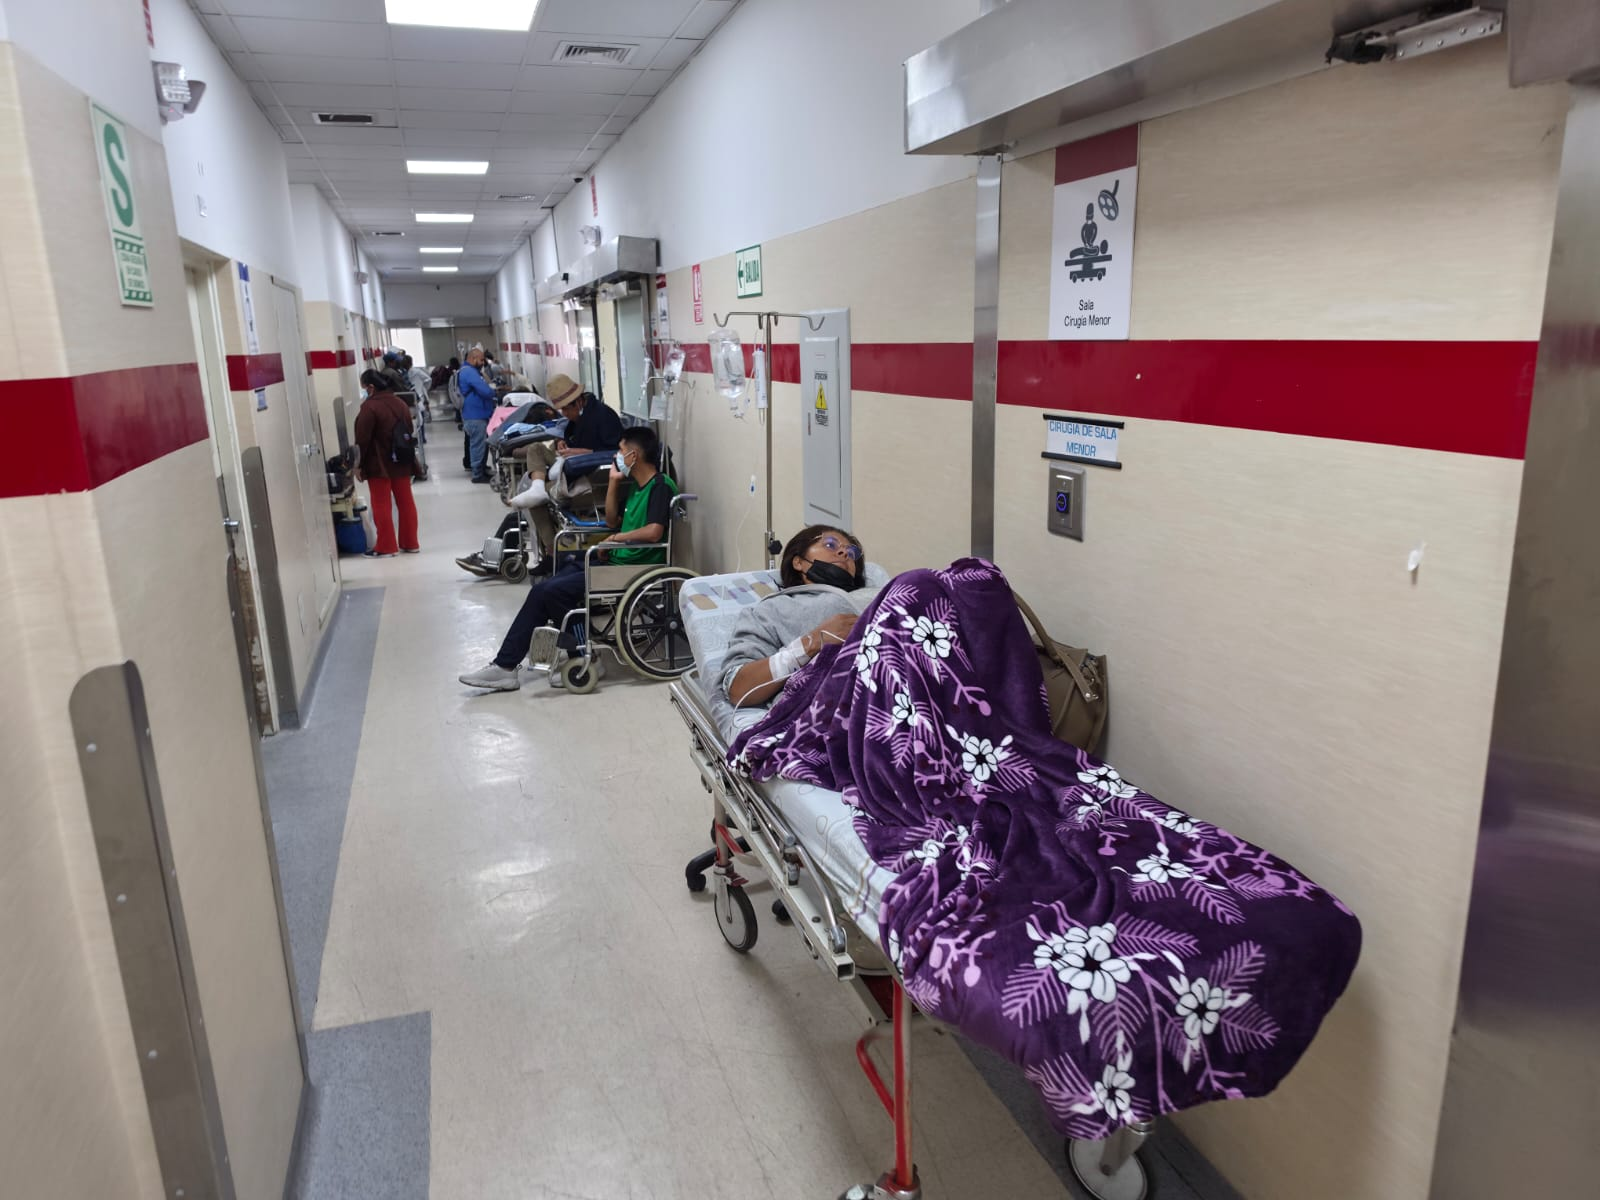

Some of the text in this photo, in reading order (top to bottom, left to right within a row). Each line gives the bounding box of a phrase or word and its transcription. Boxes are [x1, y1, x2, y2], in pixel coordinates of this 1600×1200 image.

[103, 122, 134, 228] S
[1078, 299, 1094, 311] Sala
[1088, 315, 1111, 326] Menor
[1081, 425, 1093, 438] DE
[1094, 427, 1117, 440] SALA
[1066, 441, 1096, 456] MENOR
